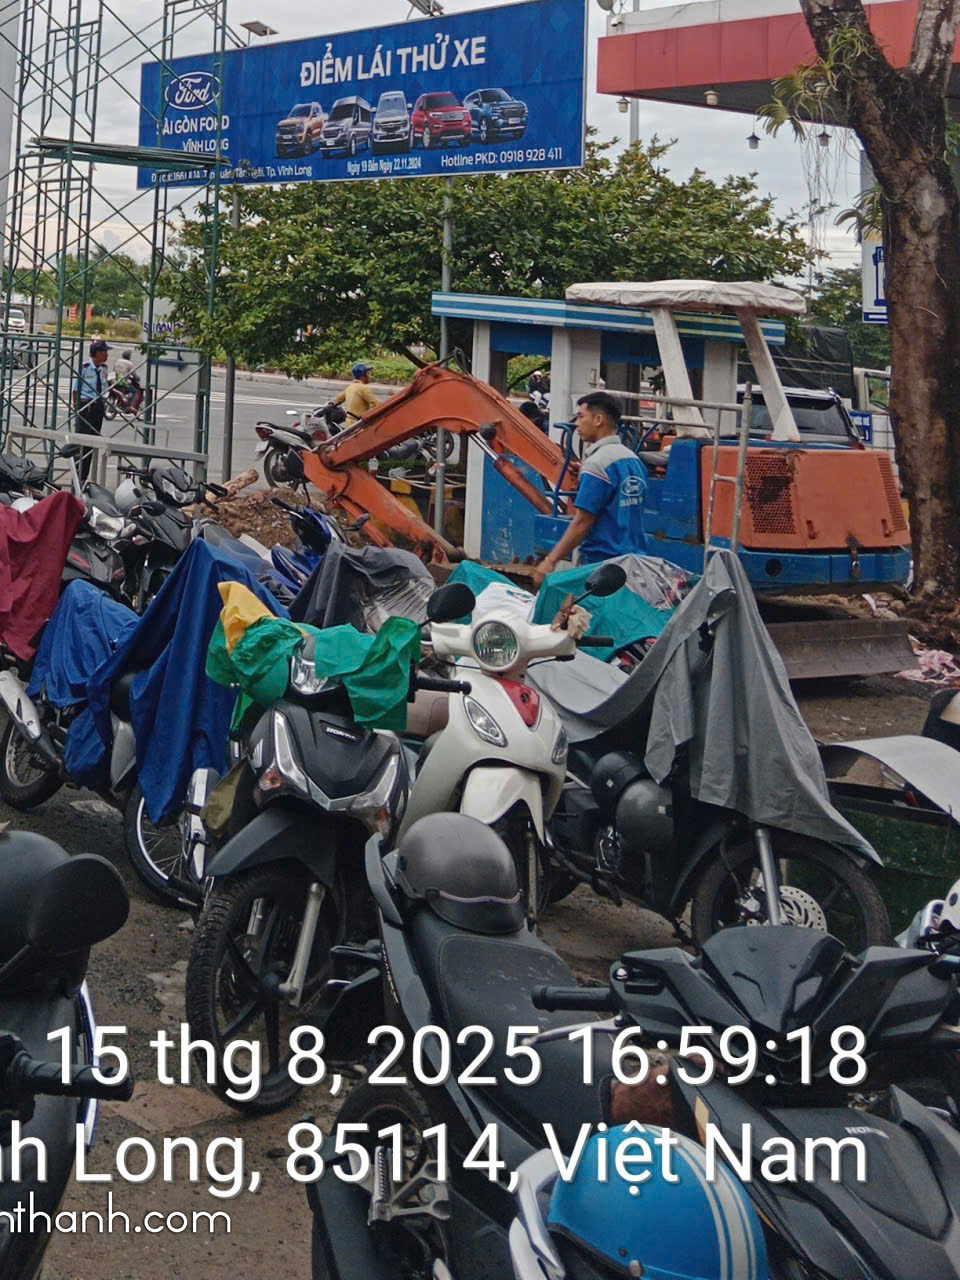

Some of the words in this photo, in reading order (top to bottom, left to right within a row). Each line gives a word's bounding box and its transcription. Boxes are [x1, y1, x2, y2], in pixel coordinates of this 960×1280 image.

[299, 42, 354, 88] ĐIỂM
[357, 44, 392, 81] LÁI
[396, 32, 451, 75] THỬ
[452, 35, 487, 68] XE
[174, 77, 211, 104] Ford
[156, 117, 173, 136] ÀI
[174, 115, 198, 133] GÒN
[204, 138, 230, 152] LOG
[441, 154, 474, 168] Hotline
[474, 152, 498, 165] PKD:
[499, 150, 524, 163] 0918
[525, 148, 545, 161] 928
[547, 147, 563, 160] 411
[294, 165, 313, 177] Long
